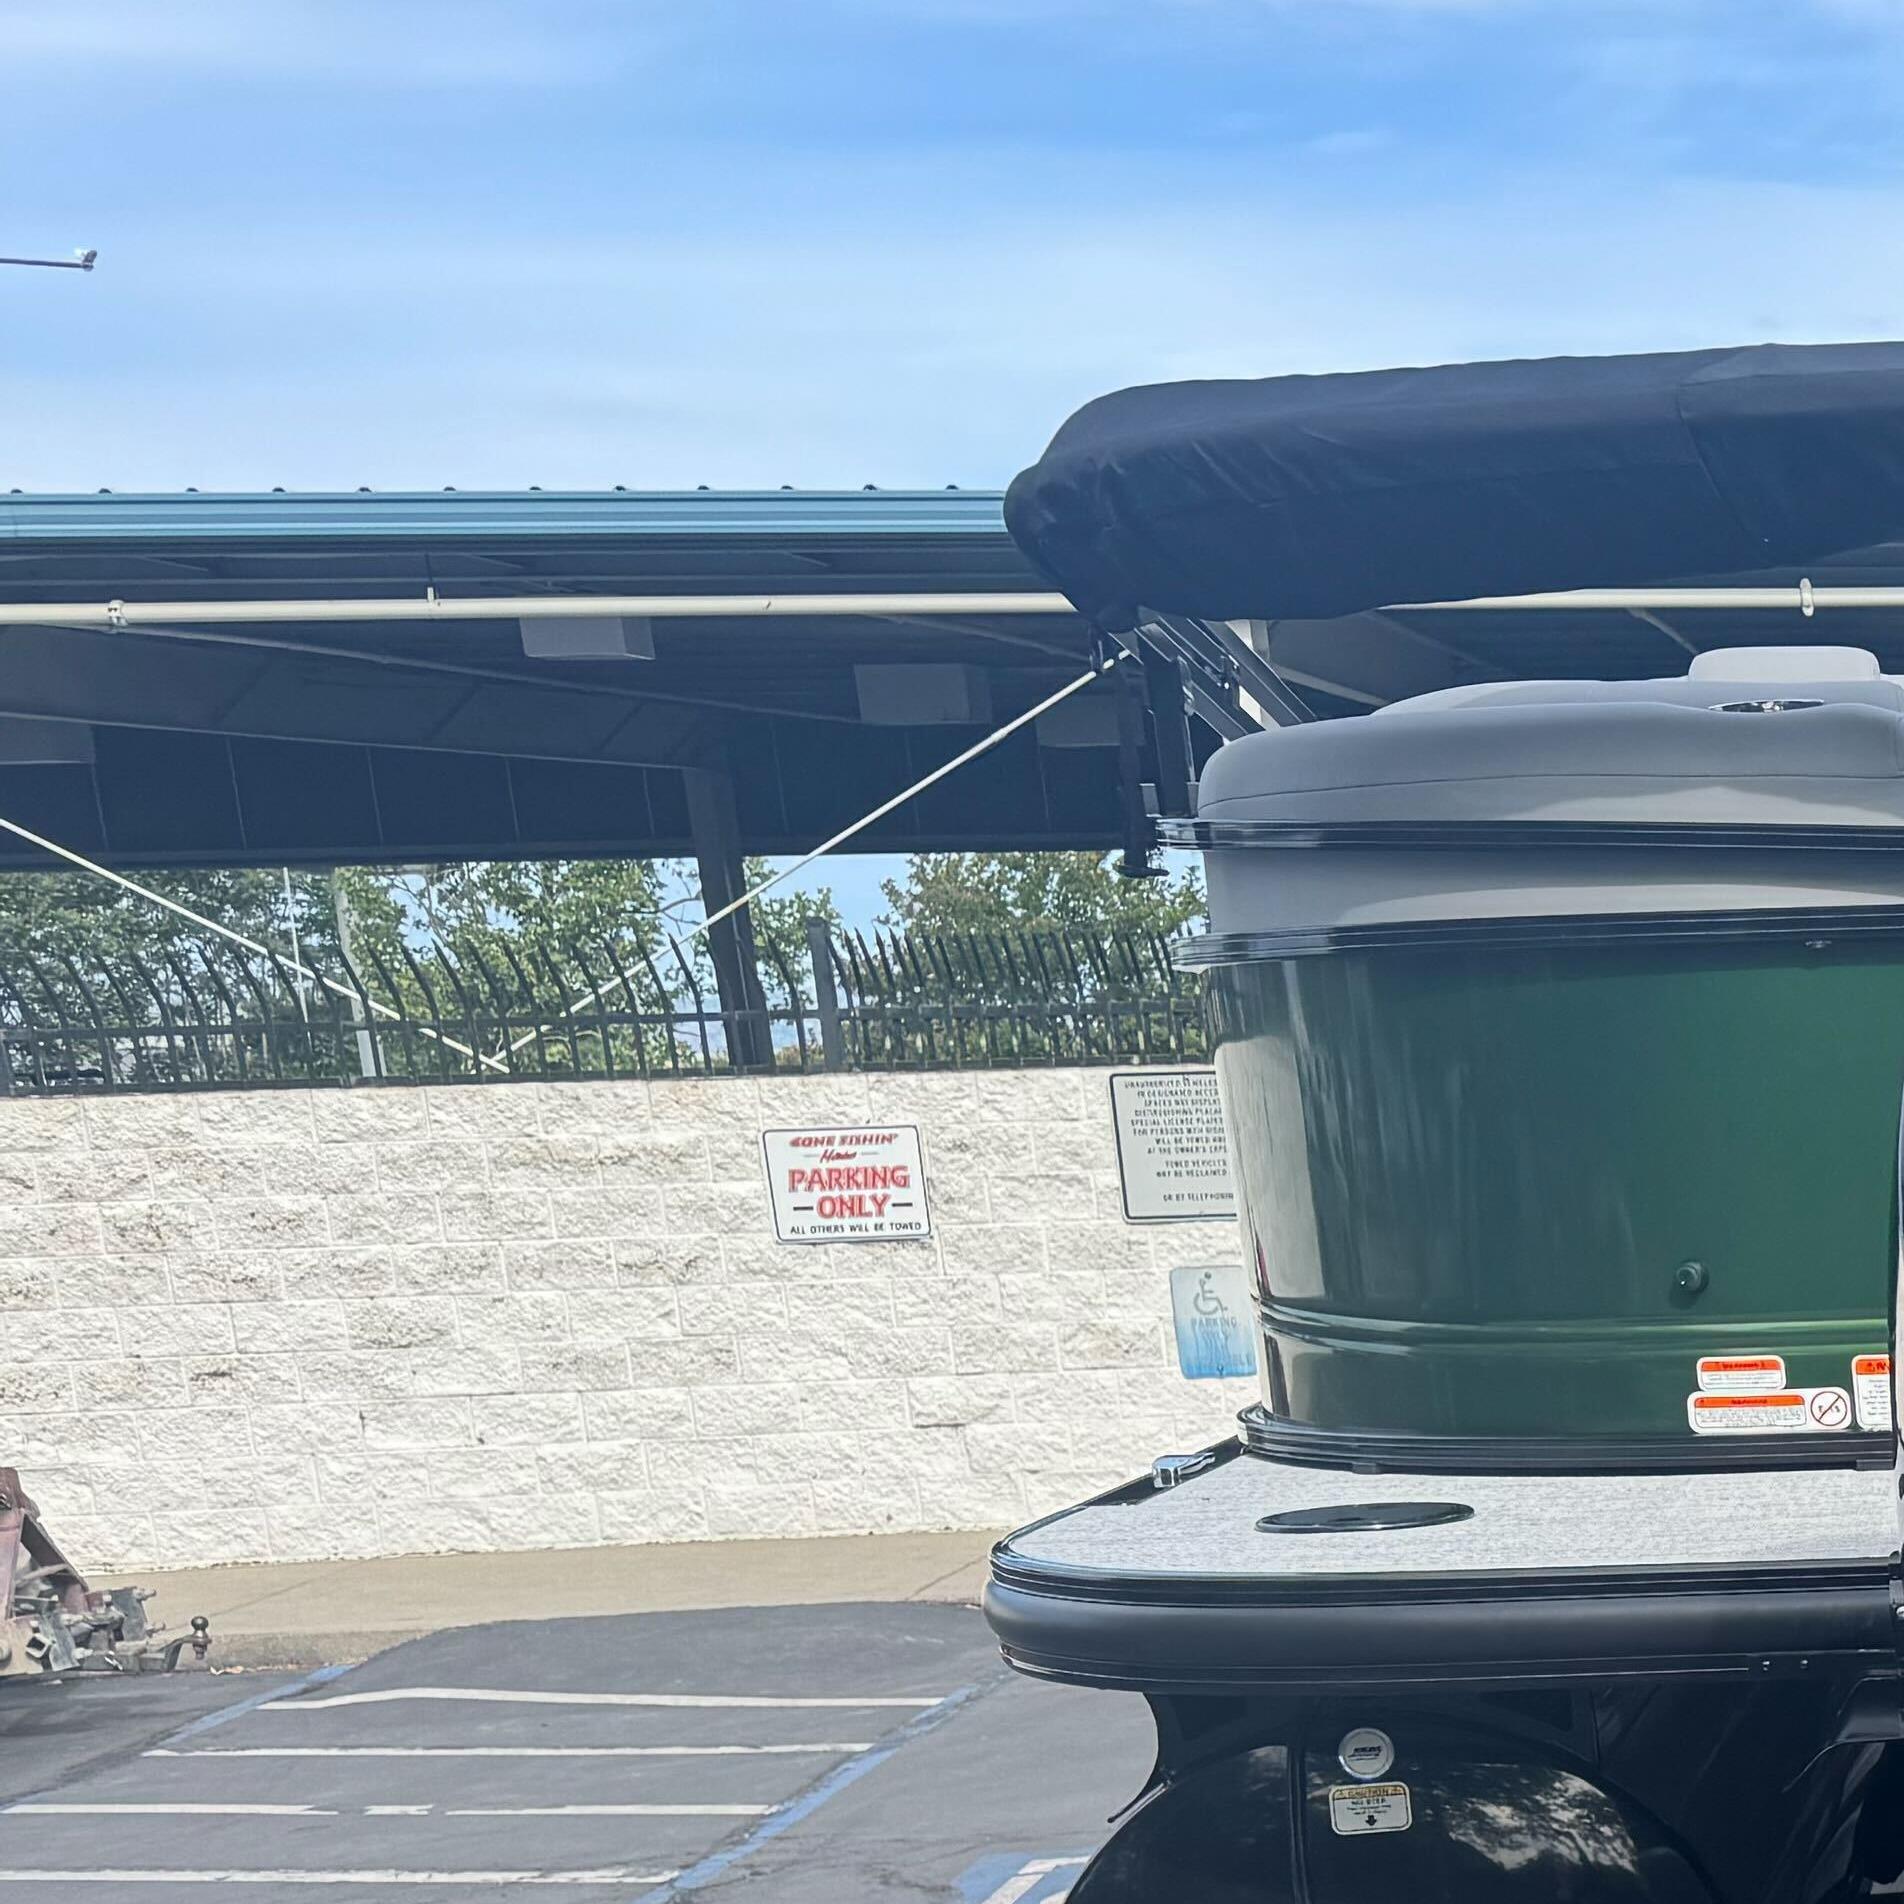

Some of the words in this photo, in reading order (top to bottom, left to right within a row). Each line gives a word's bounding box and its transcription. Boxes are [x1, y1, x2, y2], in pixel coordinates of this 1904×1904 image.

[788, 1165, 911, 1193] PARKING
[816, 1194, 892, 1220] ONLY
[790, 1225, 805, 1235] ALL
